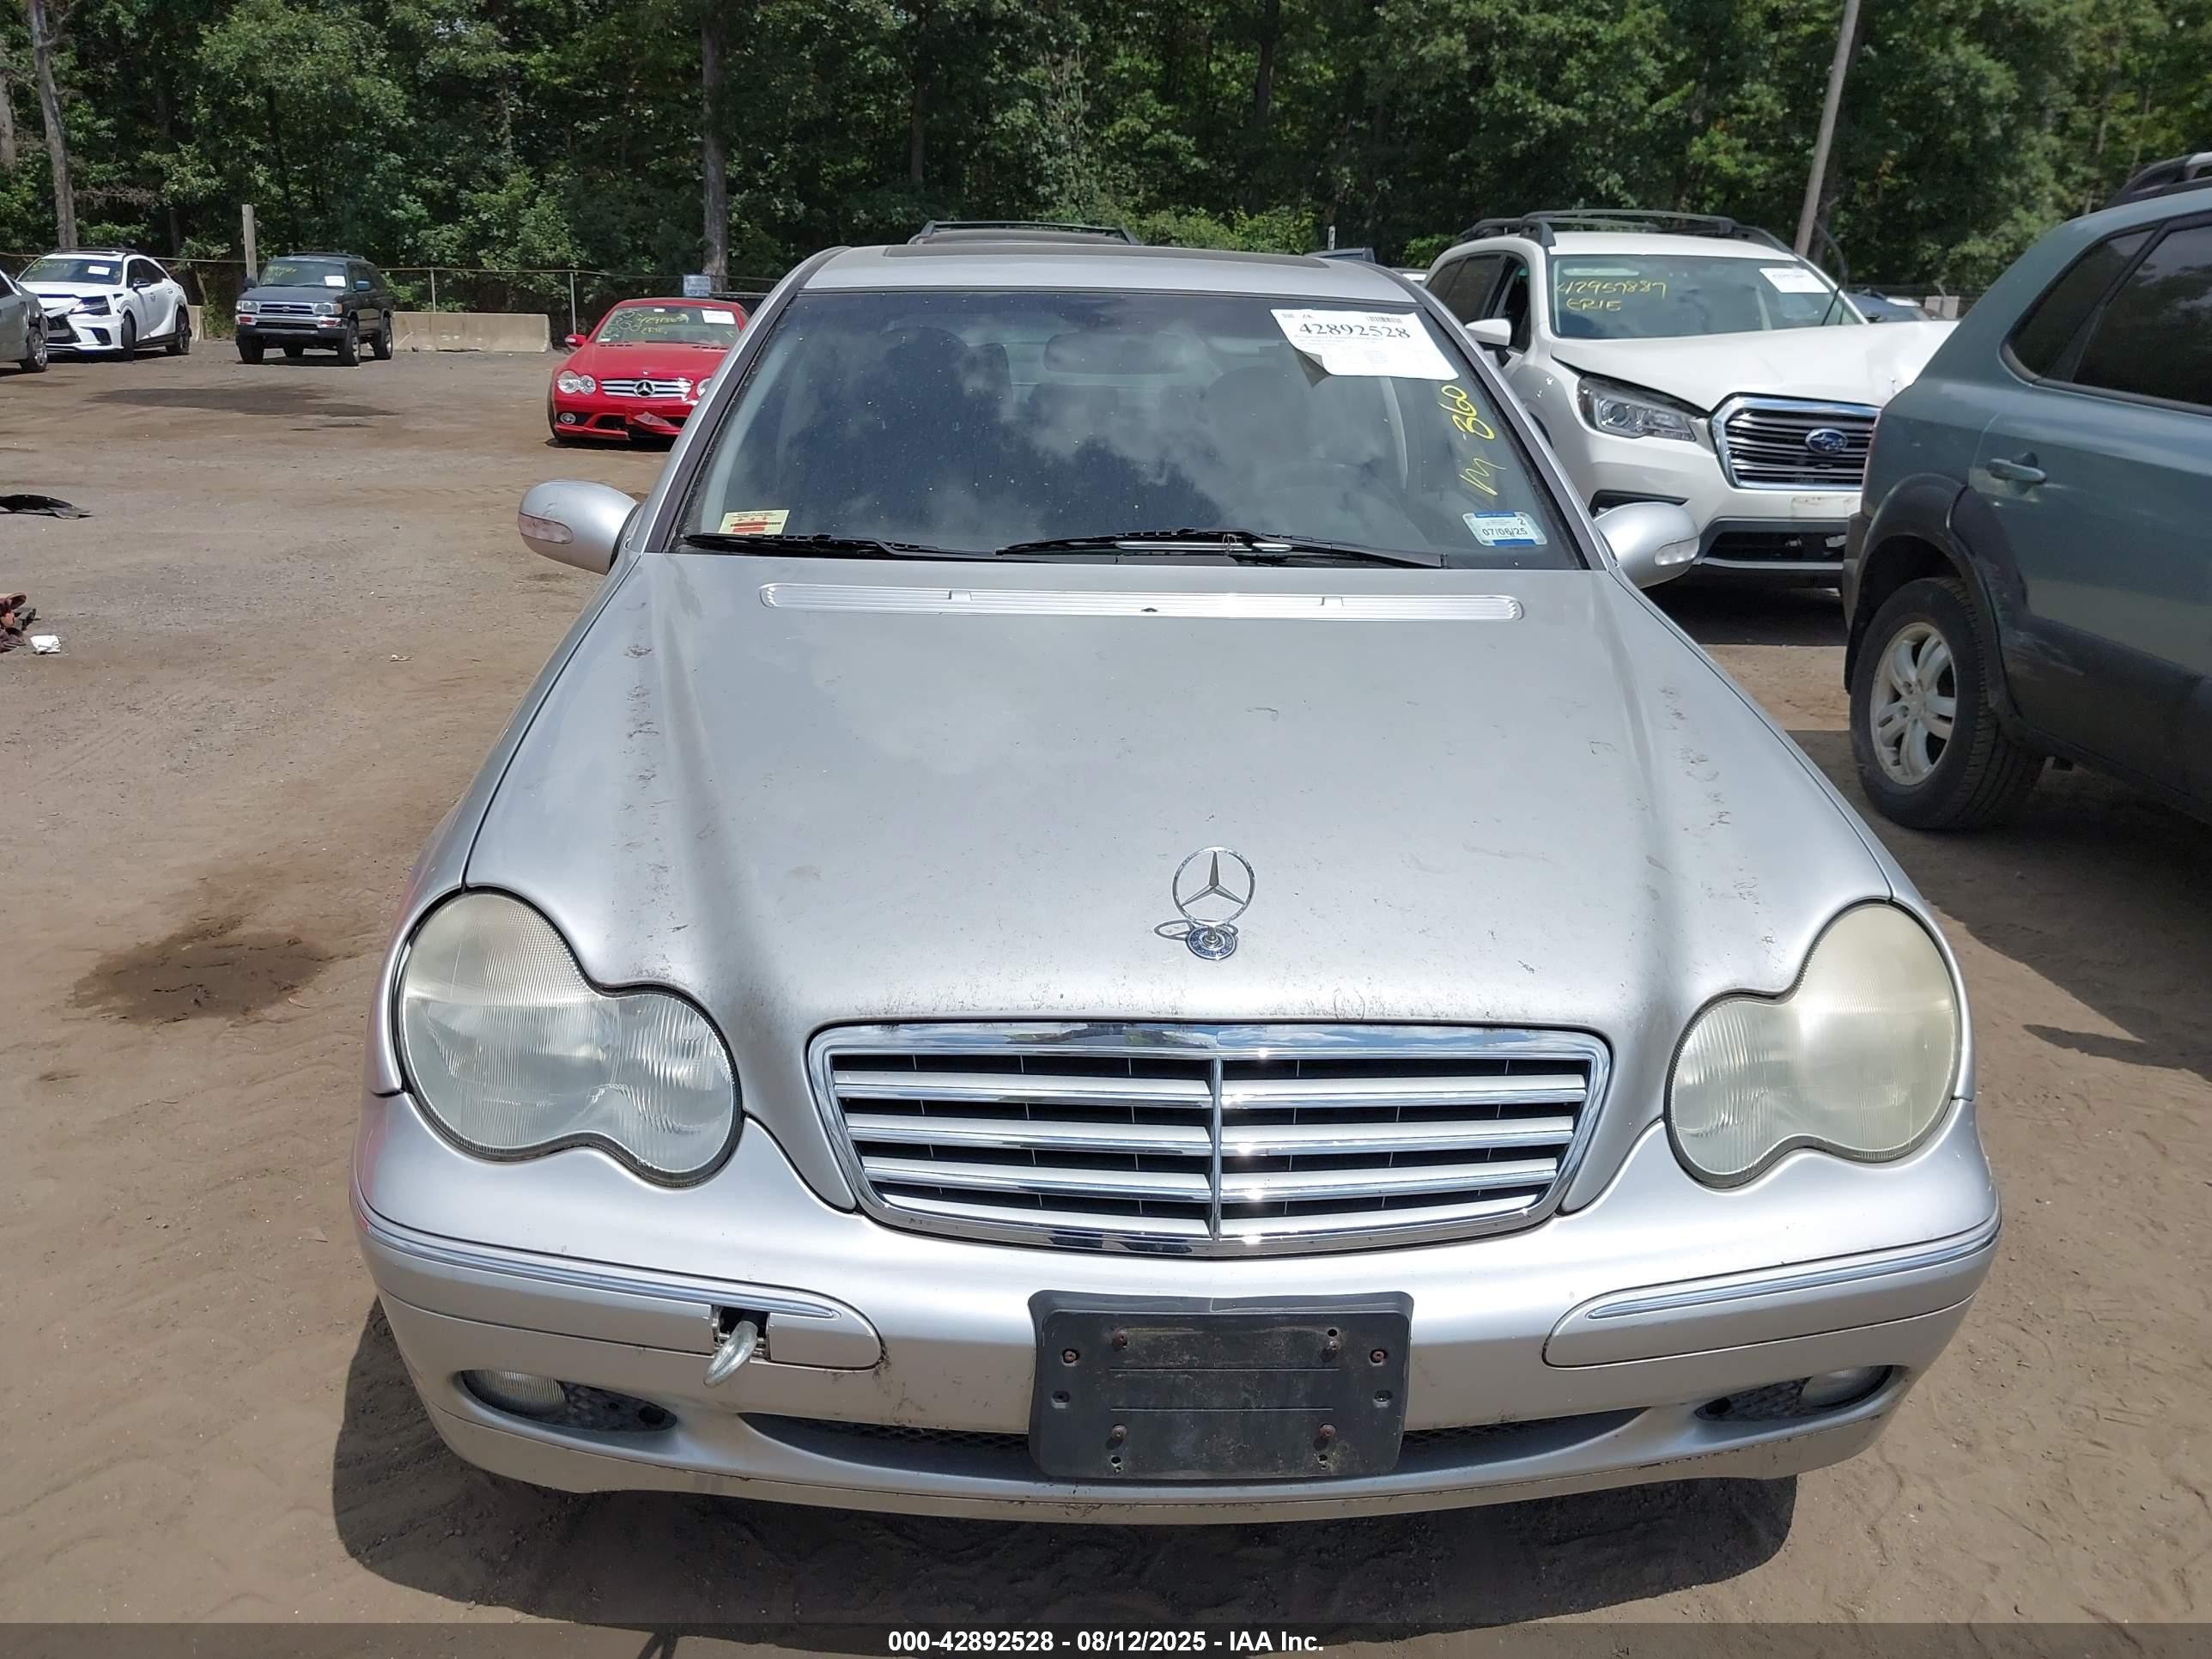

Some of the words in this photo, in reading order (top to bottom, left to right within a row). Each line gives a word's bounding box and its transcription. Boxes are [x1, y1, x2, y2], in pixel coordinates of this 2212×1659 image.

[1565, 297, 1622, 311] ERIE
[1299, 323, 1411, 339] 42892528
[1482, 527, 1528, 537] 07/06/25
